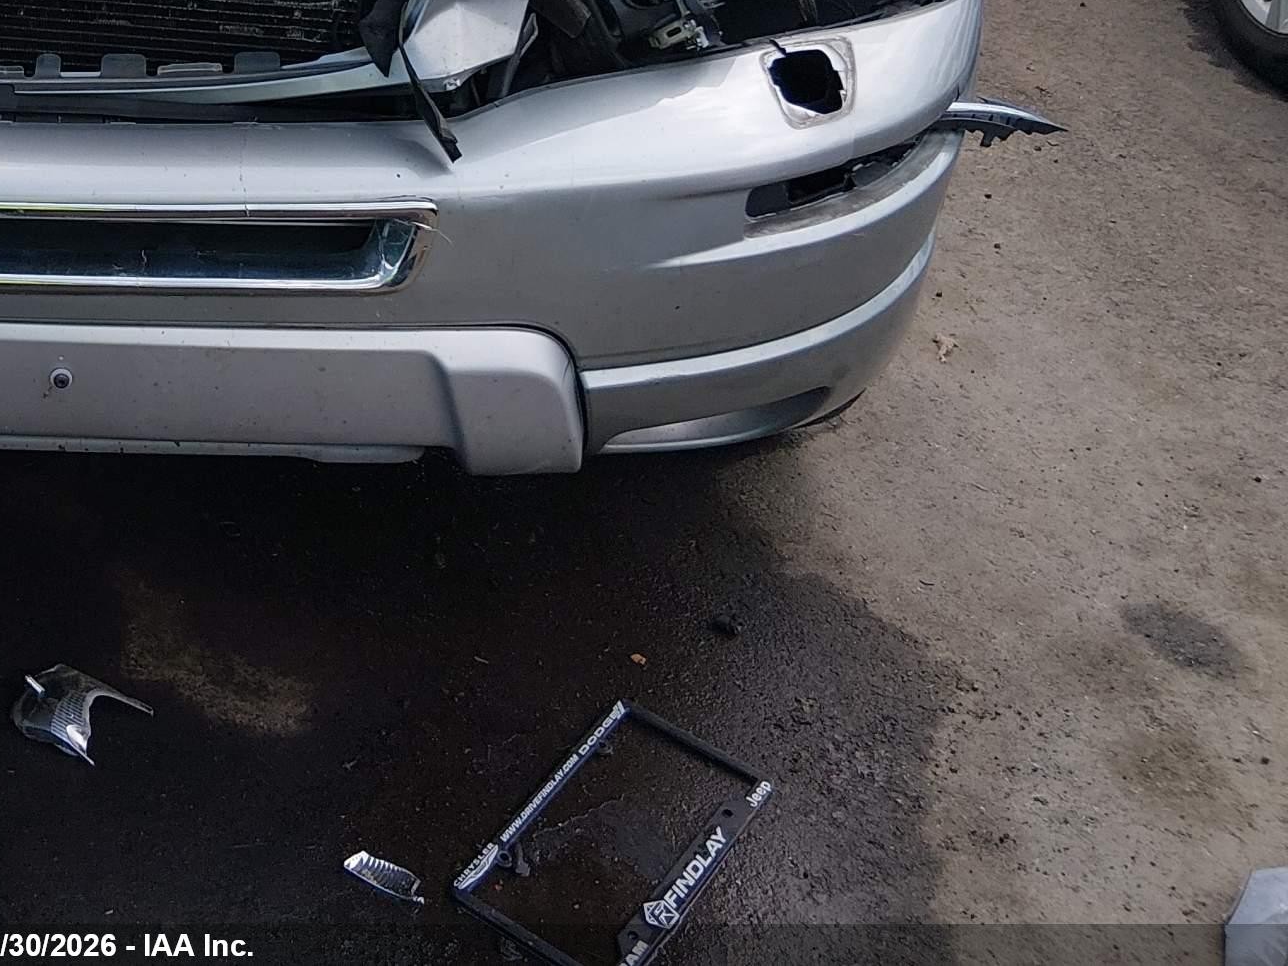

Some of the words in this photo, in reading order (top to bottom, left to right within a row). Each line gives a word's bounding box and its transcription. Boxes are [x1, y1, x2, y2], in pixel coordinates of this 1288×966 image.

[453, 841, 496, 887] CHRYSLER
[499, 753, 580, 843] WWW.DRIVEFINDLAY.COM
[578, 707, 621, 757] DODGE
[745, 780, 773, 809] Jeep
[664, 825, 730, 909] FINDLAY
[618, 939, 649, 966] AM
